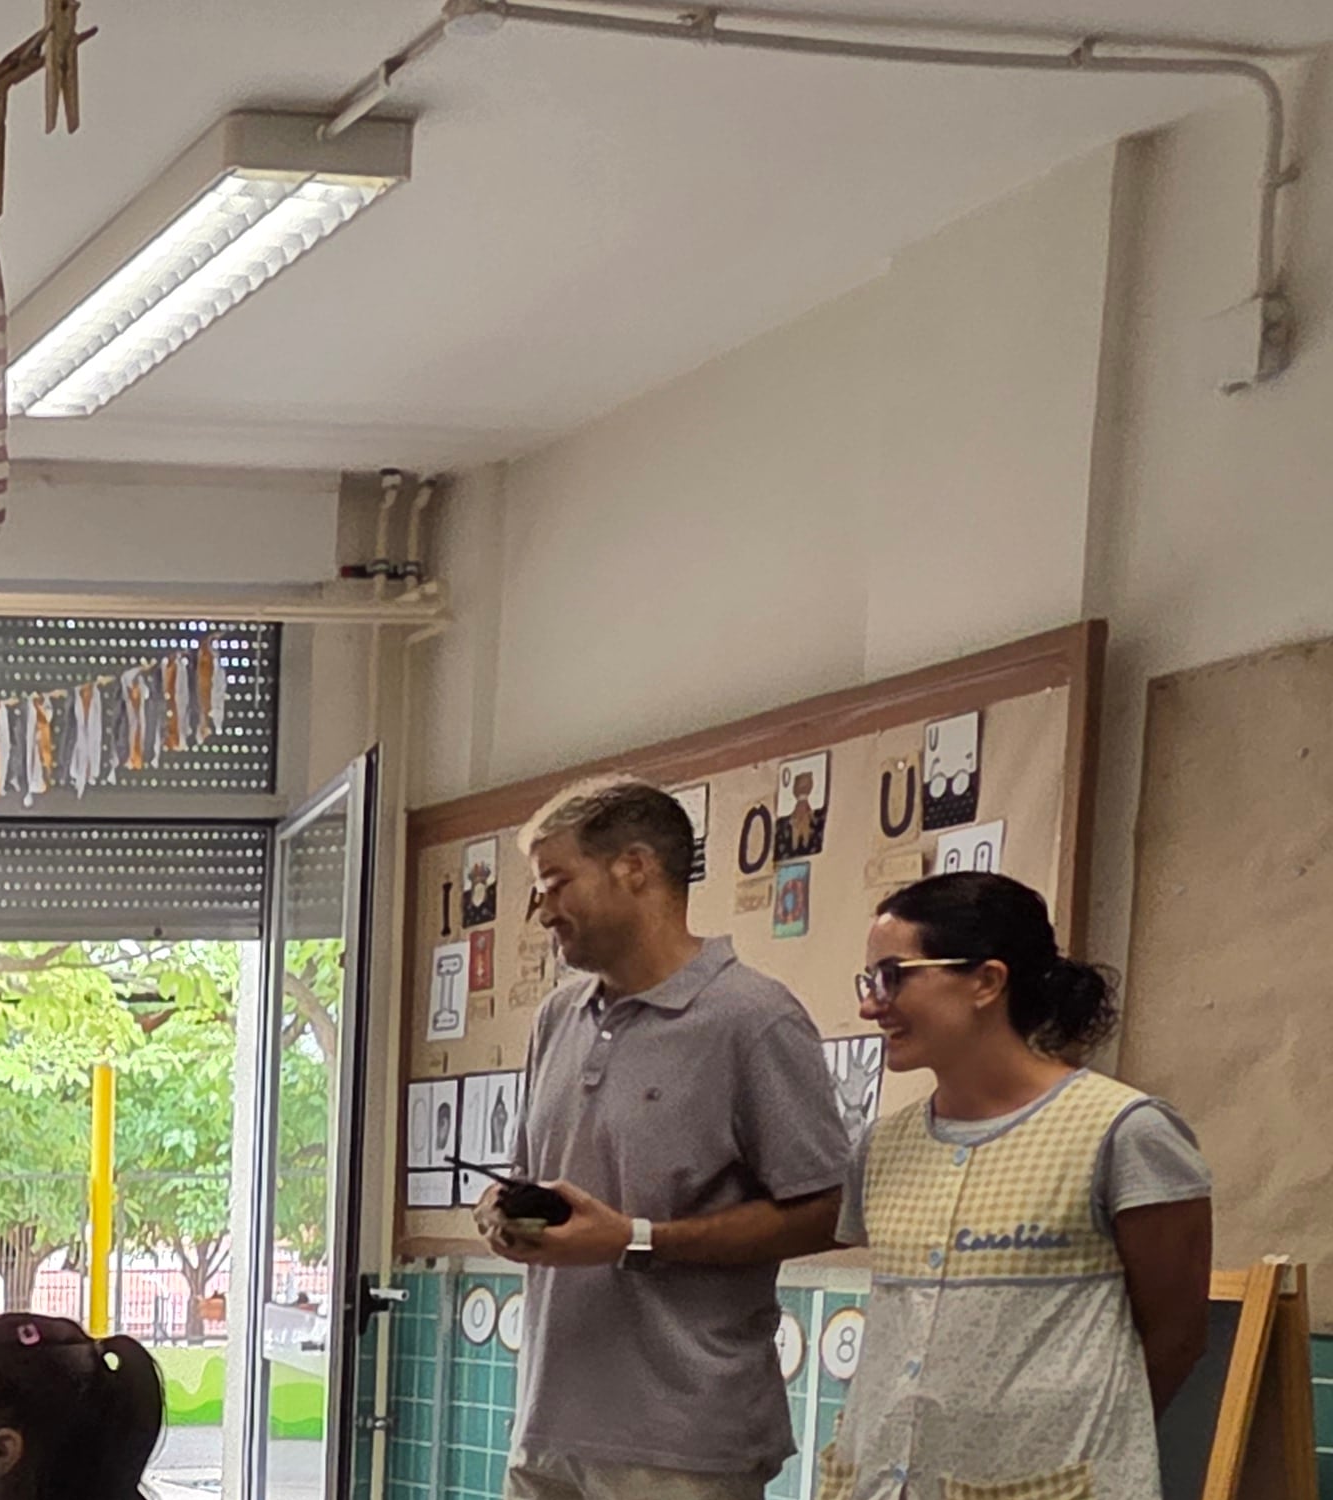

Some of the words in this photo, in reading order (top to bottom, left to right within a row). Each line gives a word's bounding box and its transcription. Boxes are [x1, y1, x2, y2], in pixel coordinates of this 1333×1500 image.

[929, 726, 939, 752] U
[881, 766, 915, 838] U
[738, 804, 772, 874] O
[441, 881, 453, 937] I
[836, 1326, 856, 1363] 8
